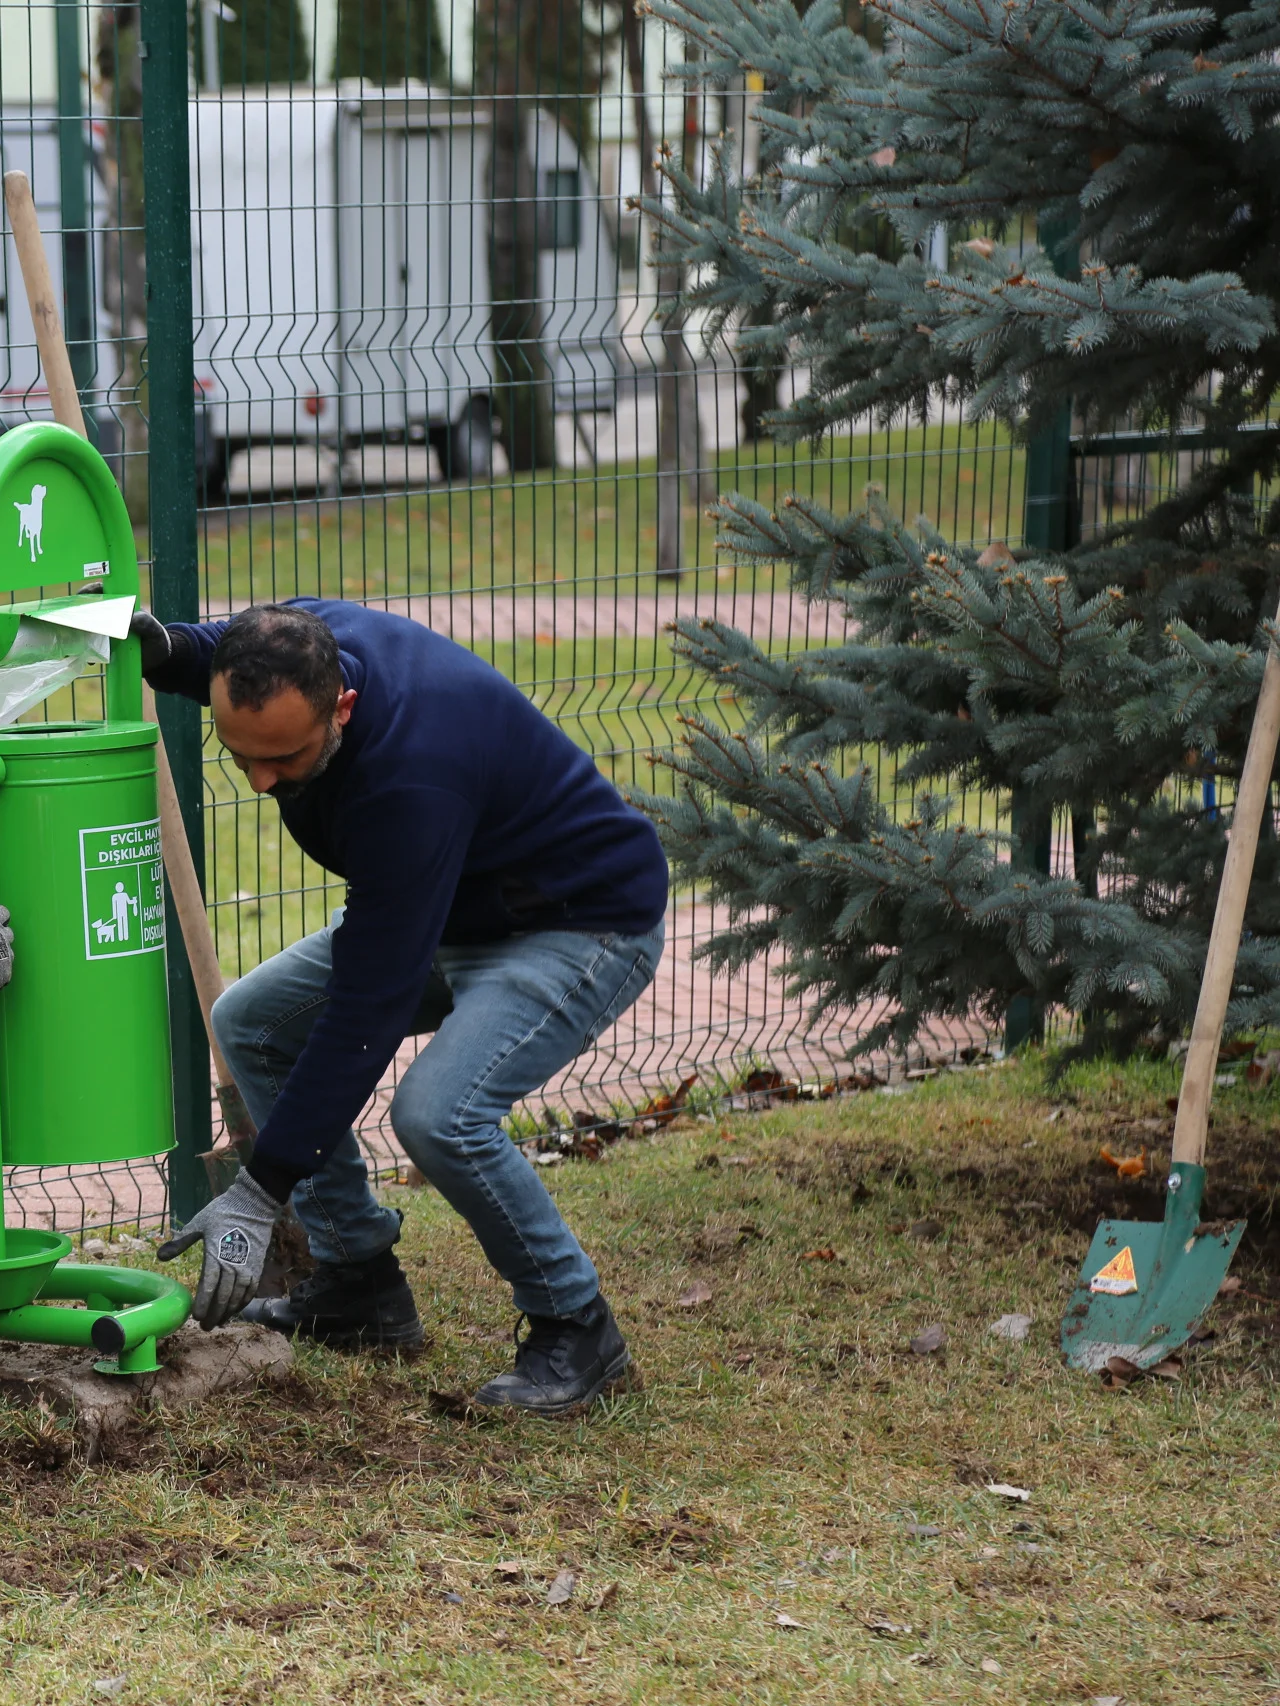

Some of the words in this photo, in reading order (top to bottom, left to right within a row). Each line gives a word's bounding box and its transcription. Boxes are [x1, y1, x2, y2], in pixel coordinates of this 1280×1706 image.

[110, 828, 143, 846] EVCİL
[99, 842, 153, 865] DIŞKILARI
[153, 839, 163, 857] İÇ
